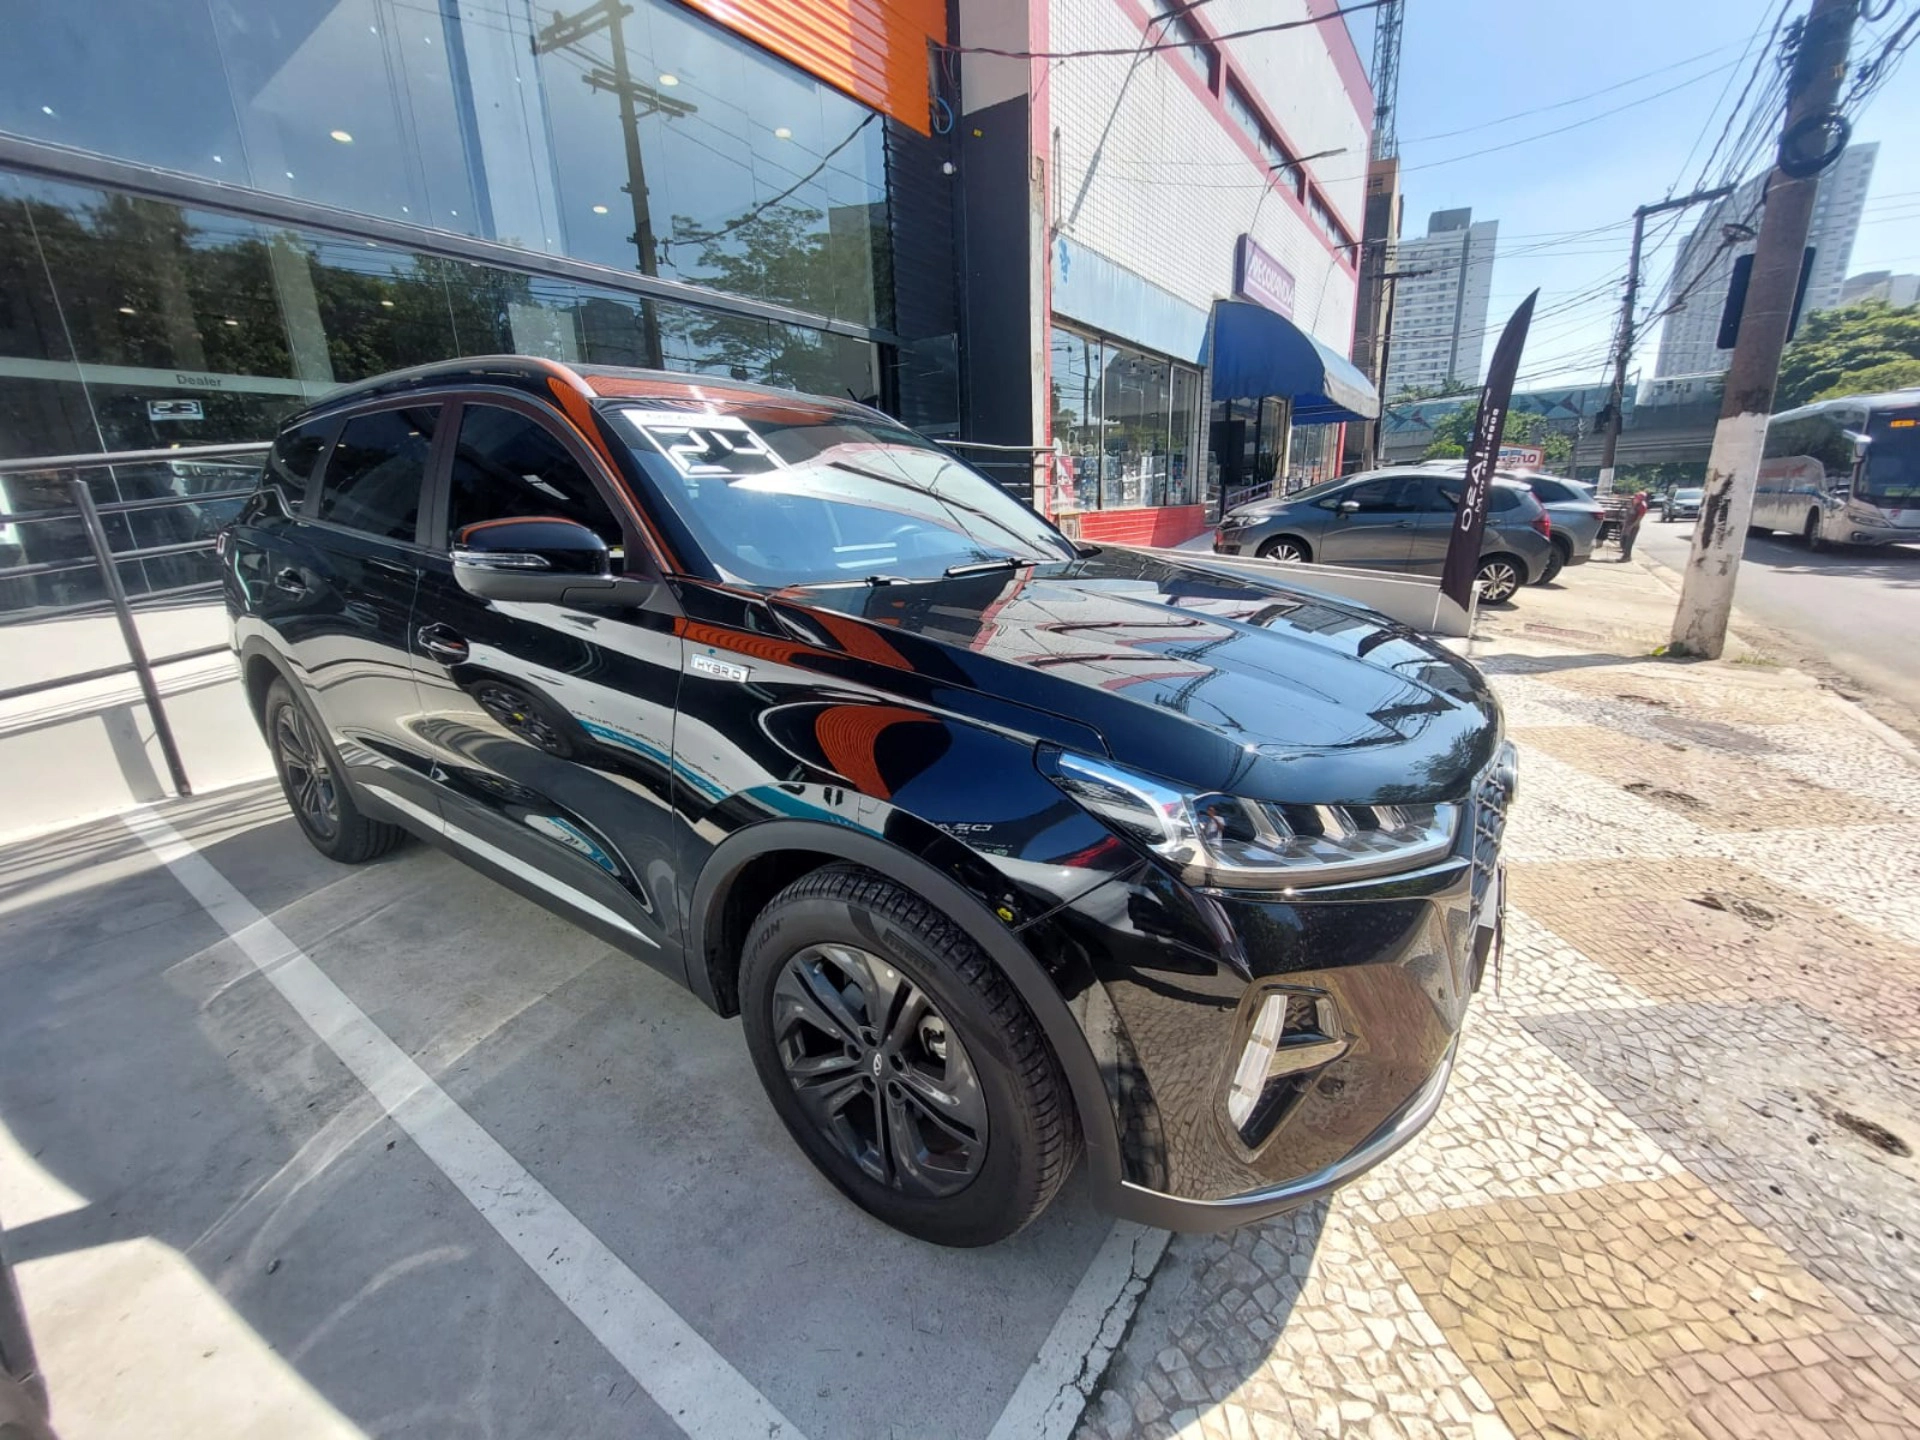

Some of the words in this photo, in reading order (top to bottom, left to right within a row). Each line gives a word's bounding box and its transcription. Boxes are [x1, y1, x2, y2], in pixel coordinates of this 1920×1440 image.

[176, 373, 222, 387] Dealer
[645, 425, 785, 474] 24
[697, 660, 741, 679] HYBRD
